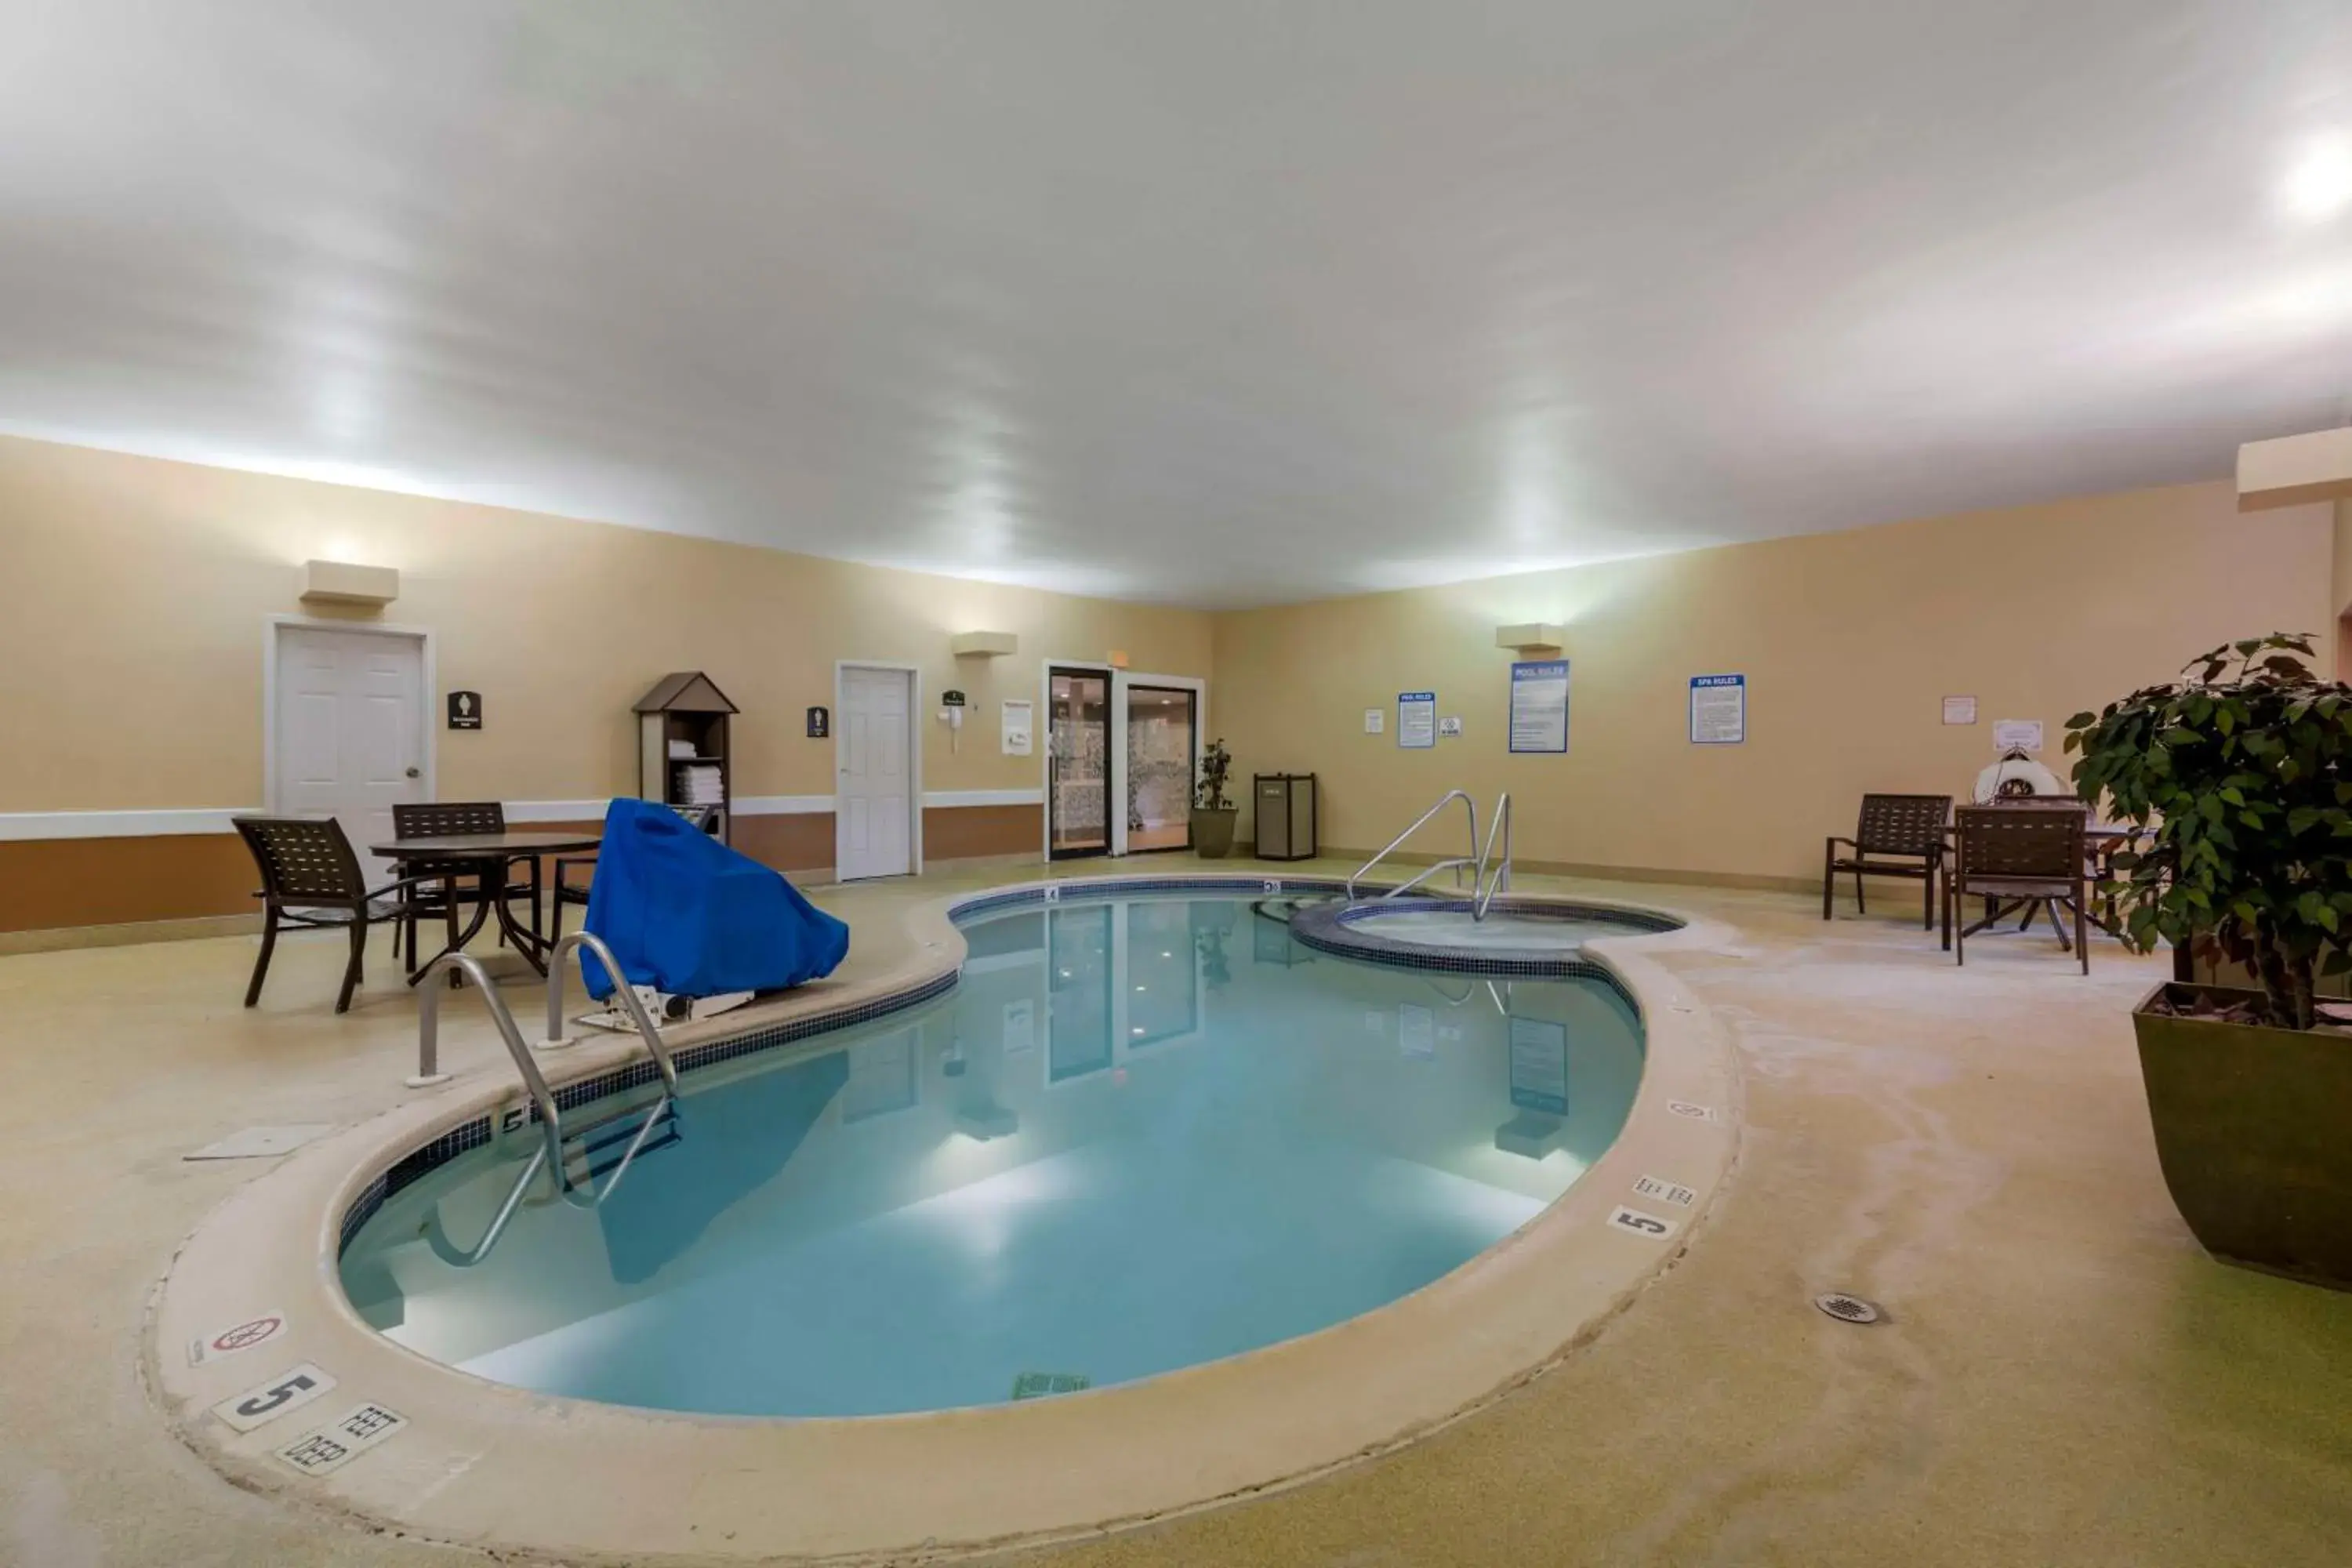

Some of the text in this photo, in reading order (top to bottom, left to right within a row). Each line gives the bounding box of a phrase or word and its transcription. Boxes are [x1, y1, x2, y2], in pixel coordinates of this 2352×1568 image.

[1617, 1212, 1668, 1235] 5
[237, 1374, 318, 1417] 5
[339, 1406, 398, 1439] FEET
[285, 1435, 348, 1468] DEEP
